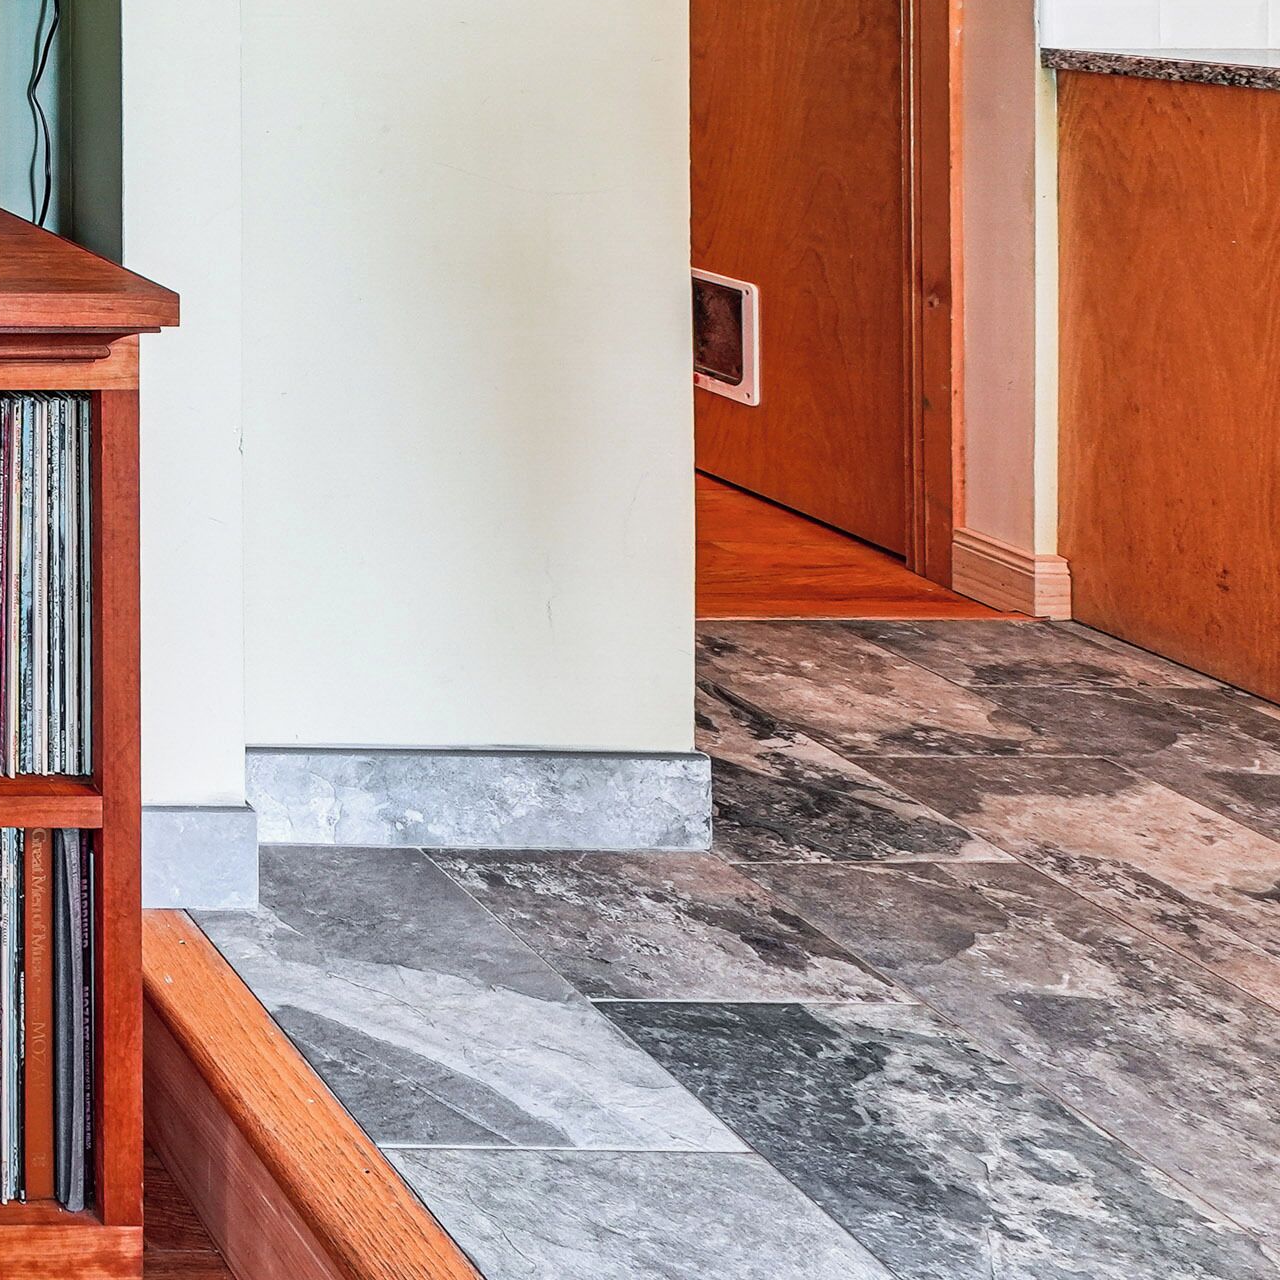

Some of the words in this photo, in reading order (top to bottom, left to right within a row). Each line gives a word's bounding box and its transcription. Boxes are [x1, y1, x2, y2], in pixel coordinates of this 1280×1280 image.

[31, 828, 46, 872] Great
[31, 876, 46, 913] Men
[31, 915, 46, 932] of
[31, 935, 46, 981] Music
